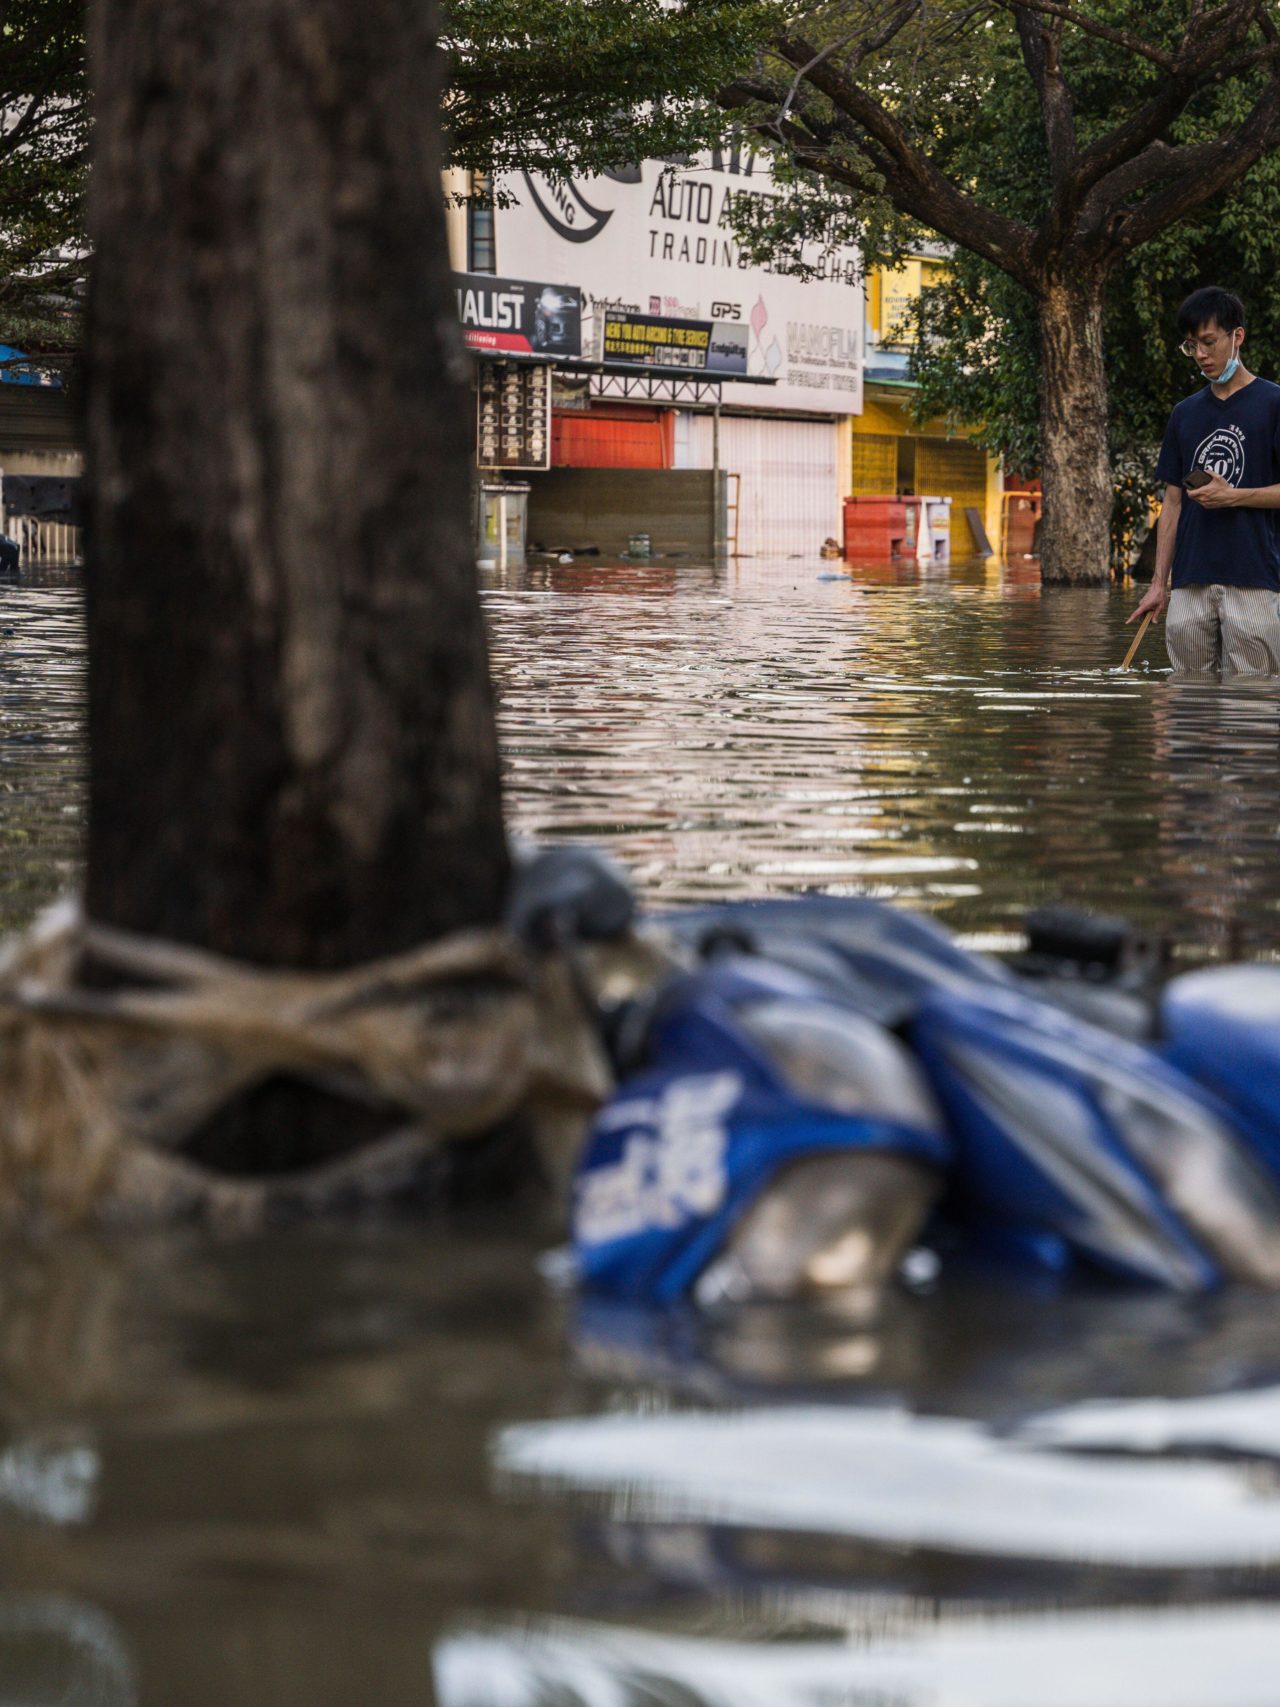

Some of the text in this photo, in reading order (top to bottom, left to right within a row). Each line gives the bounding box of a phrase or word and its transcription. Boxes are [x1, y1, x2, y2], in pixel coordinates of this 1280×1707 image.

[649, 174, 713, 225] AUTO
[649, 229, 748, 270] TRADING
[711, 301, 742, 320] GPS
